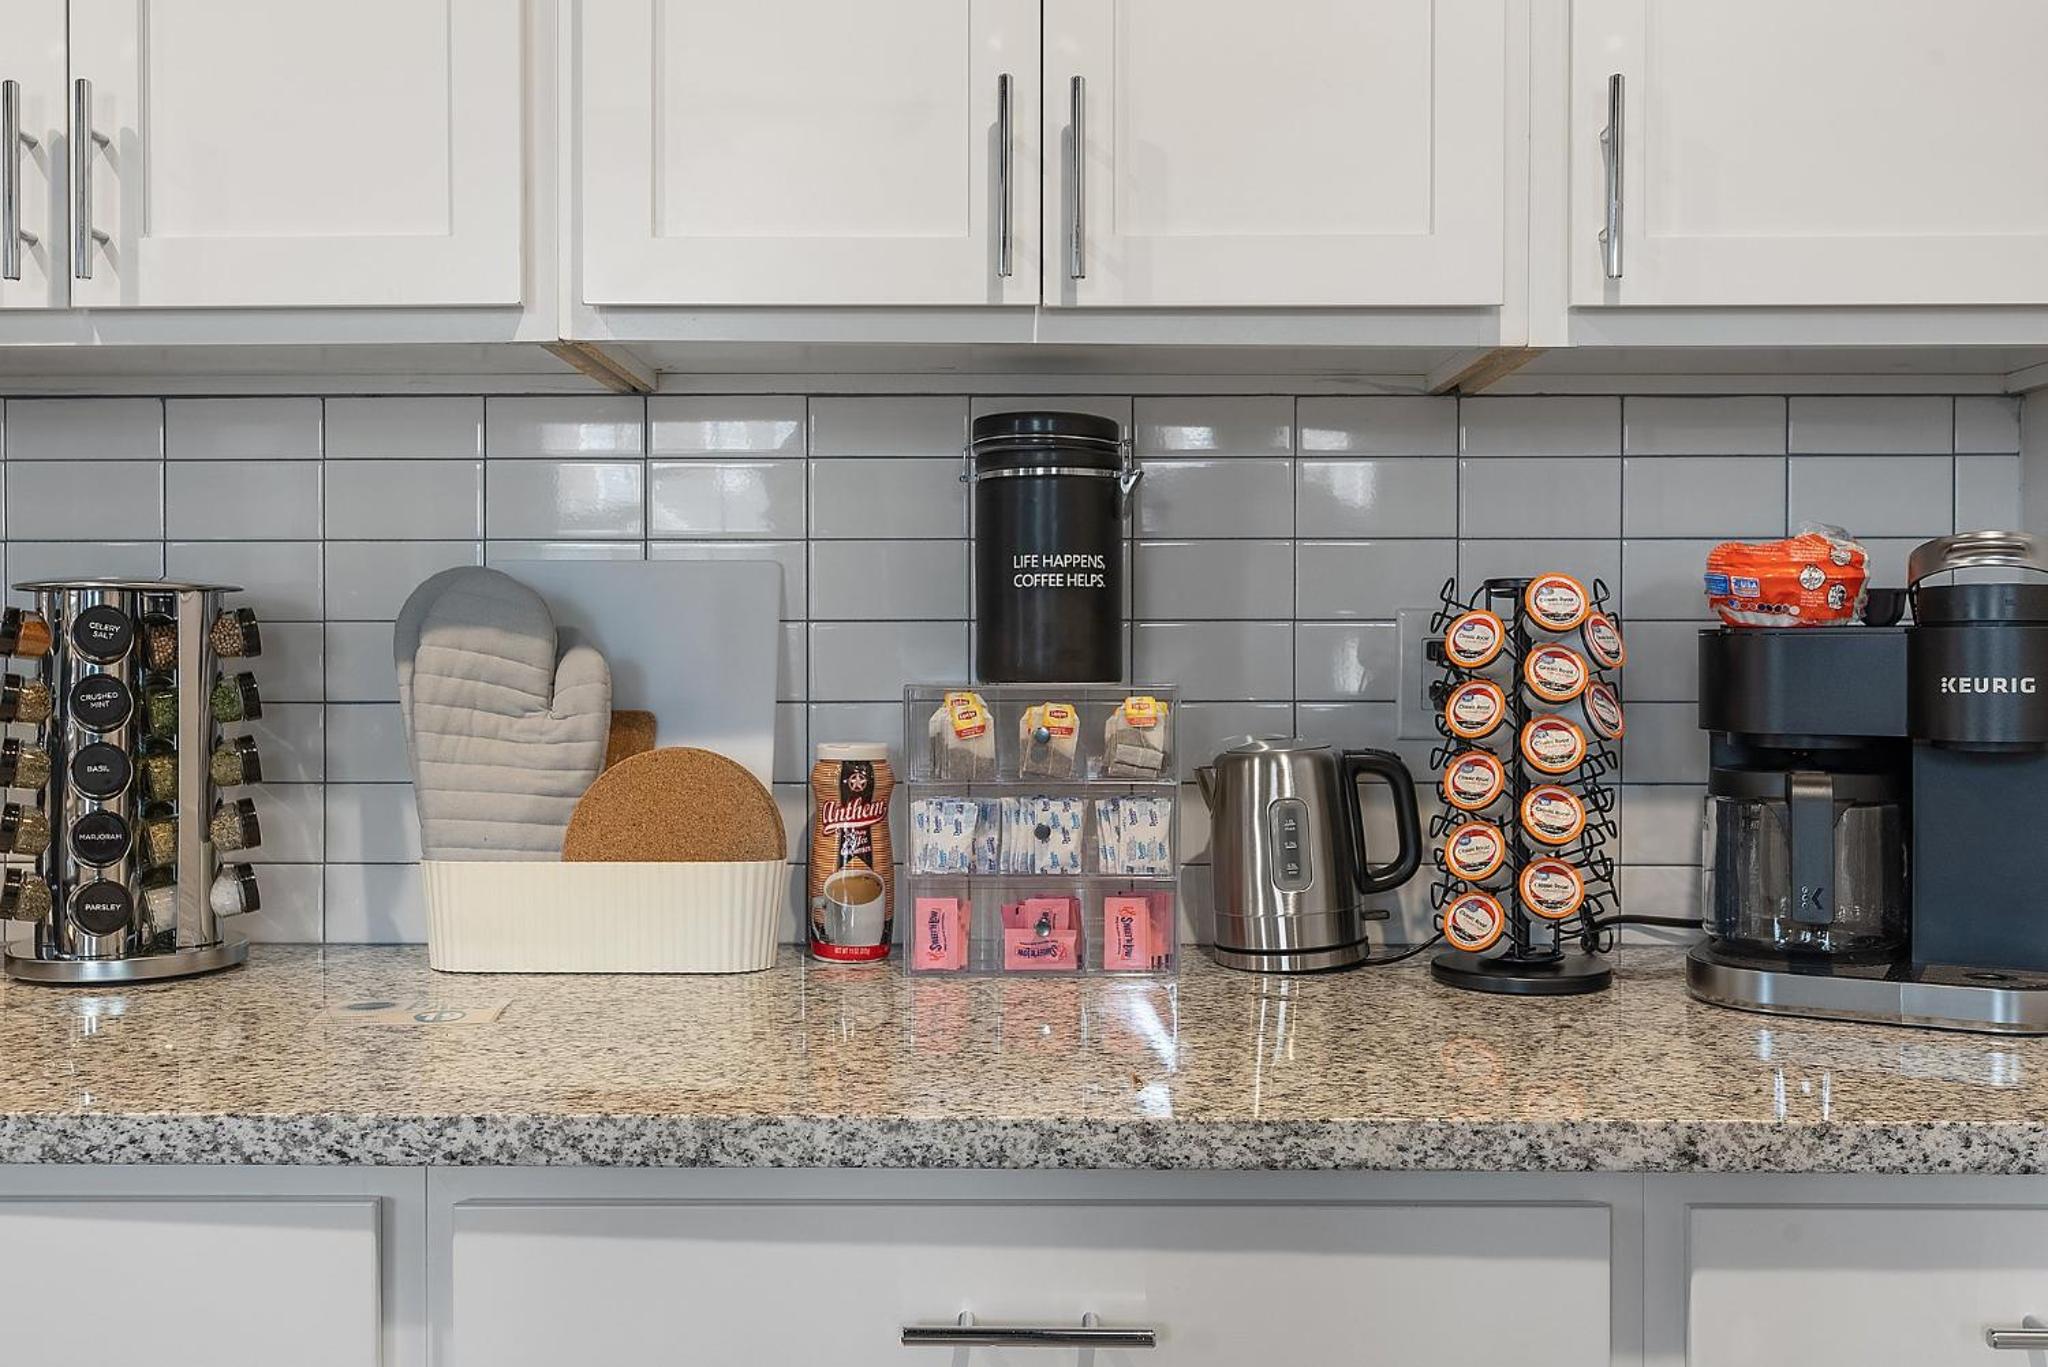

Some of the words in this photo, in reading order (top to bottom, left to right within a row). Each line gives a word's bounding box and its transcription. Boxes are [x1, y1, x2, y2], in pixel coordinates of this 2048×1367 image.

[1013, 554, 1039, 569] LIFE
[1042, 554, 1106, 570] HAPPENS,
[1013, 573, 1065, 588] COFFEE
[1067, 573, 1106, 588] HELPS.
[89, 622, 121, 633] CELERY
[92, 631, 115, 640] SALT
[1941, 677, 2036, 694] KEURIG
[80, 692, 119, 702] CRUSHED
[90, 700, 111, 709] MINT
[87, 765, 110, 773] BASIL
[823, 797, 884, 824] Anthem
[79, 833, 122, 841] MARJORAM
[85, 903, 121, 912] PARSLEY
